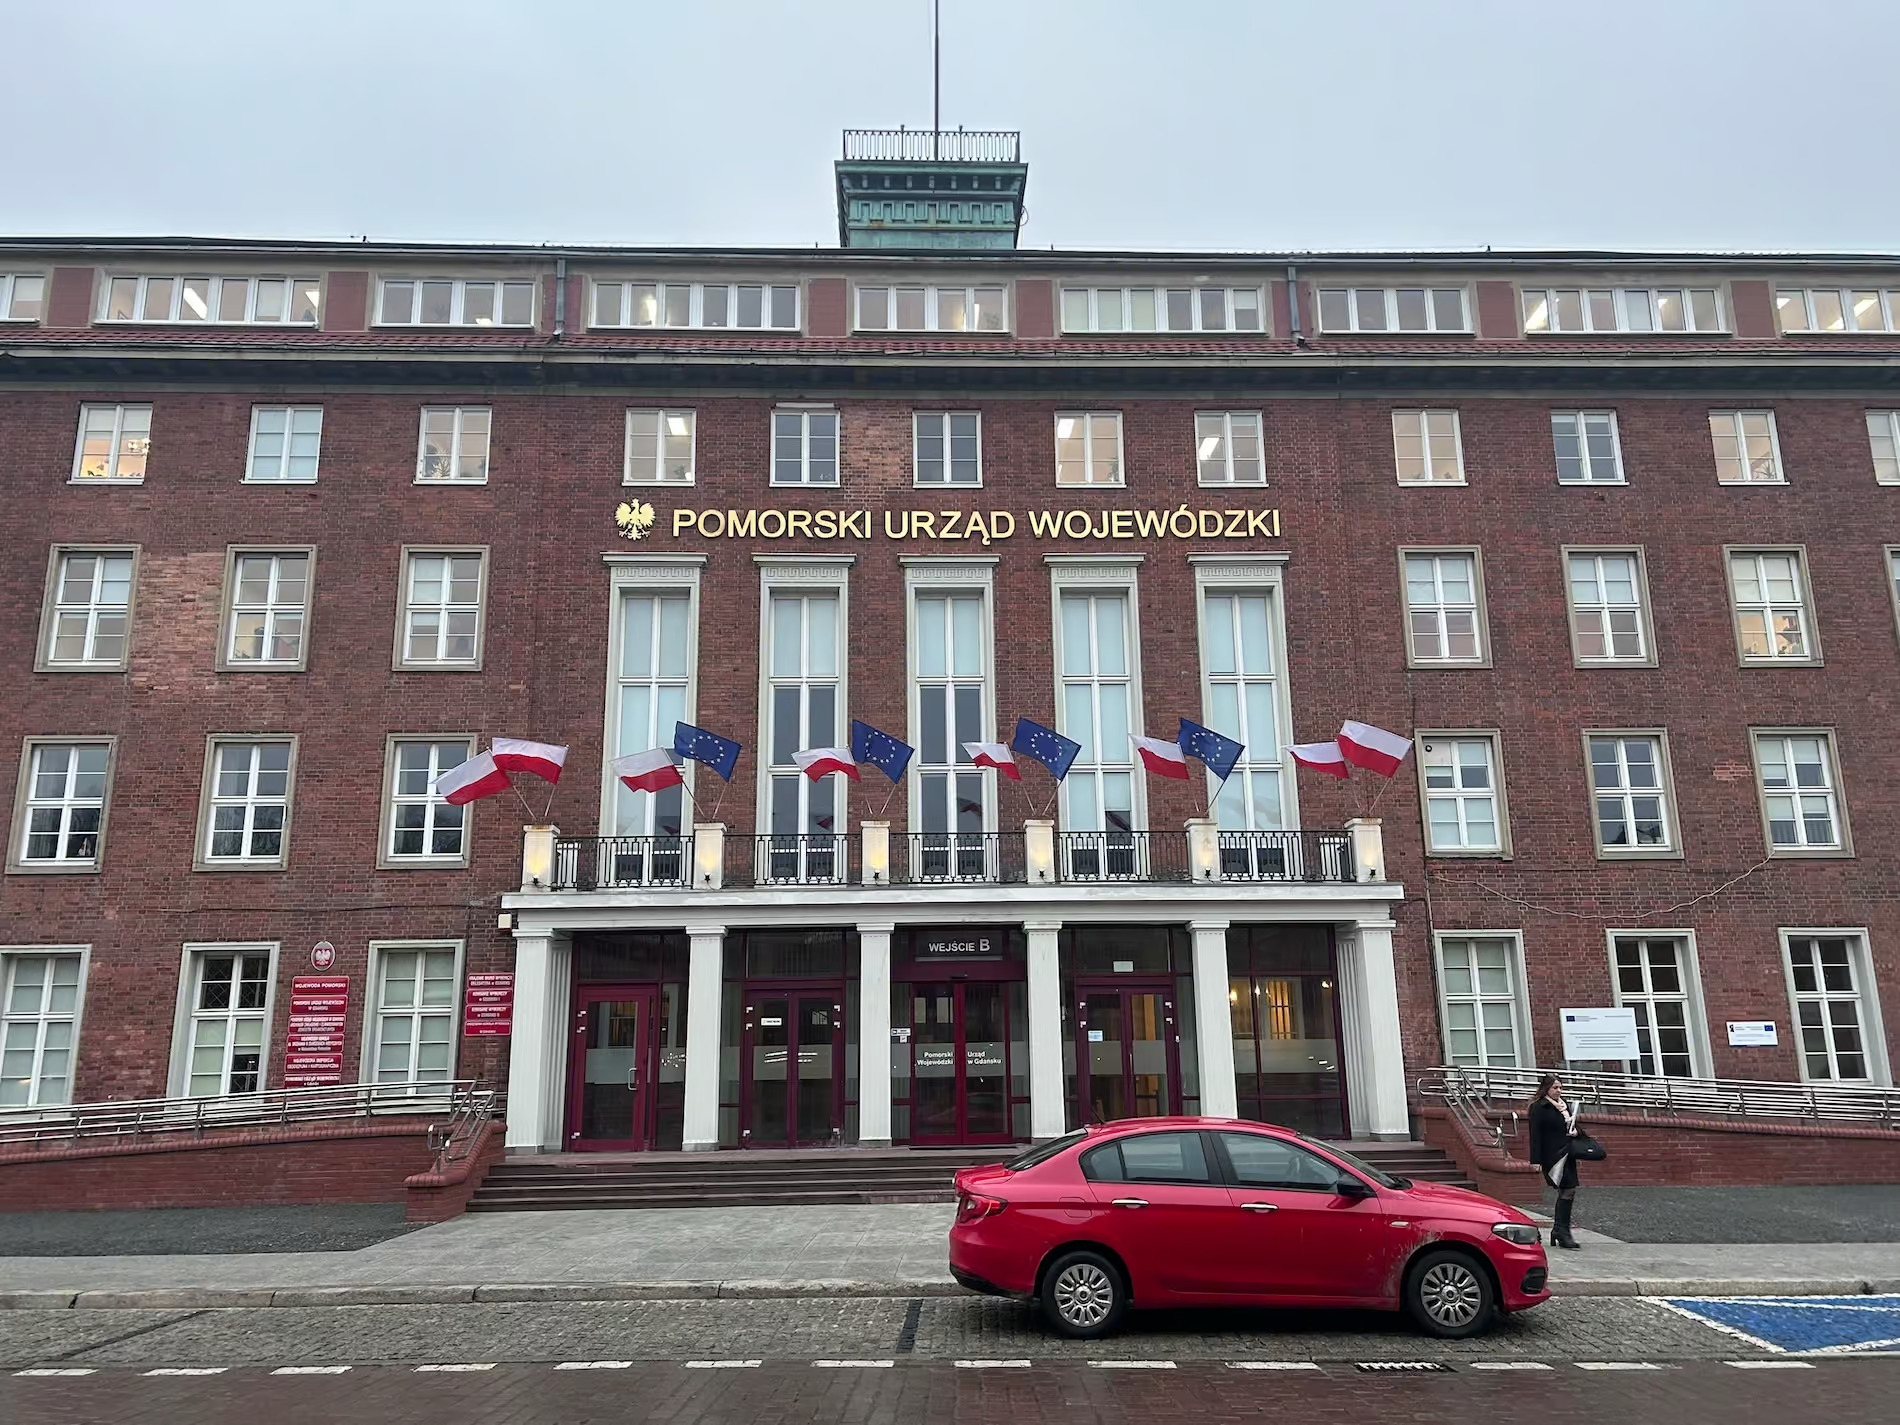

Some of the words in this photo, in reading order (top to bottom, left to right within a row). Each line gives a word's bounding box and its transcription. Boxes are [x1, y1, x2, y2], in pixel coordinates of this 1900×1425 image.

[672, 508, 872, 538] POMORSKI
[884, 510, 1015, 546] URZĄD
[1028, 504, 1281, 539] WOJEWÓDZKI
[928, 940, 976, 952] WEJŚCIE
[979, 938, 991, 952] B
[967, 1051, 986, 1059] Urząd
[917, 1058, 953, 1066] Wojewódzki
